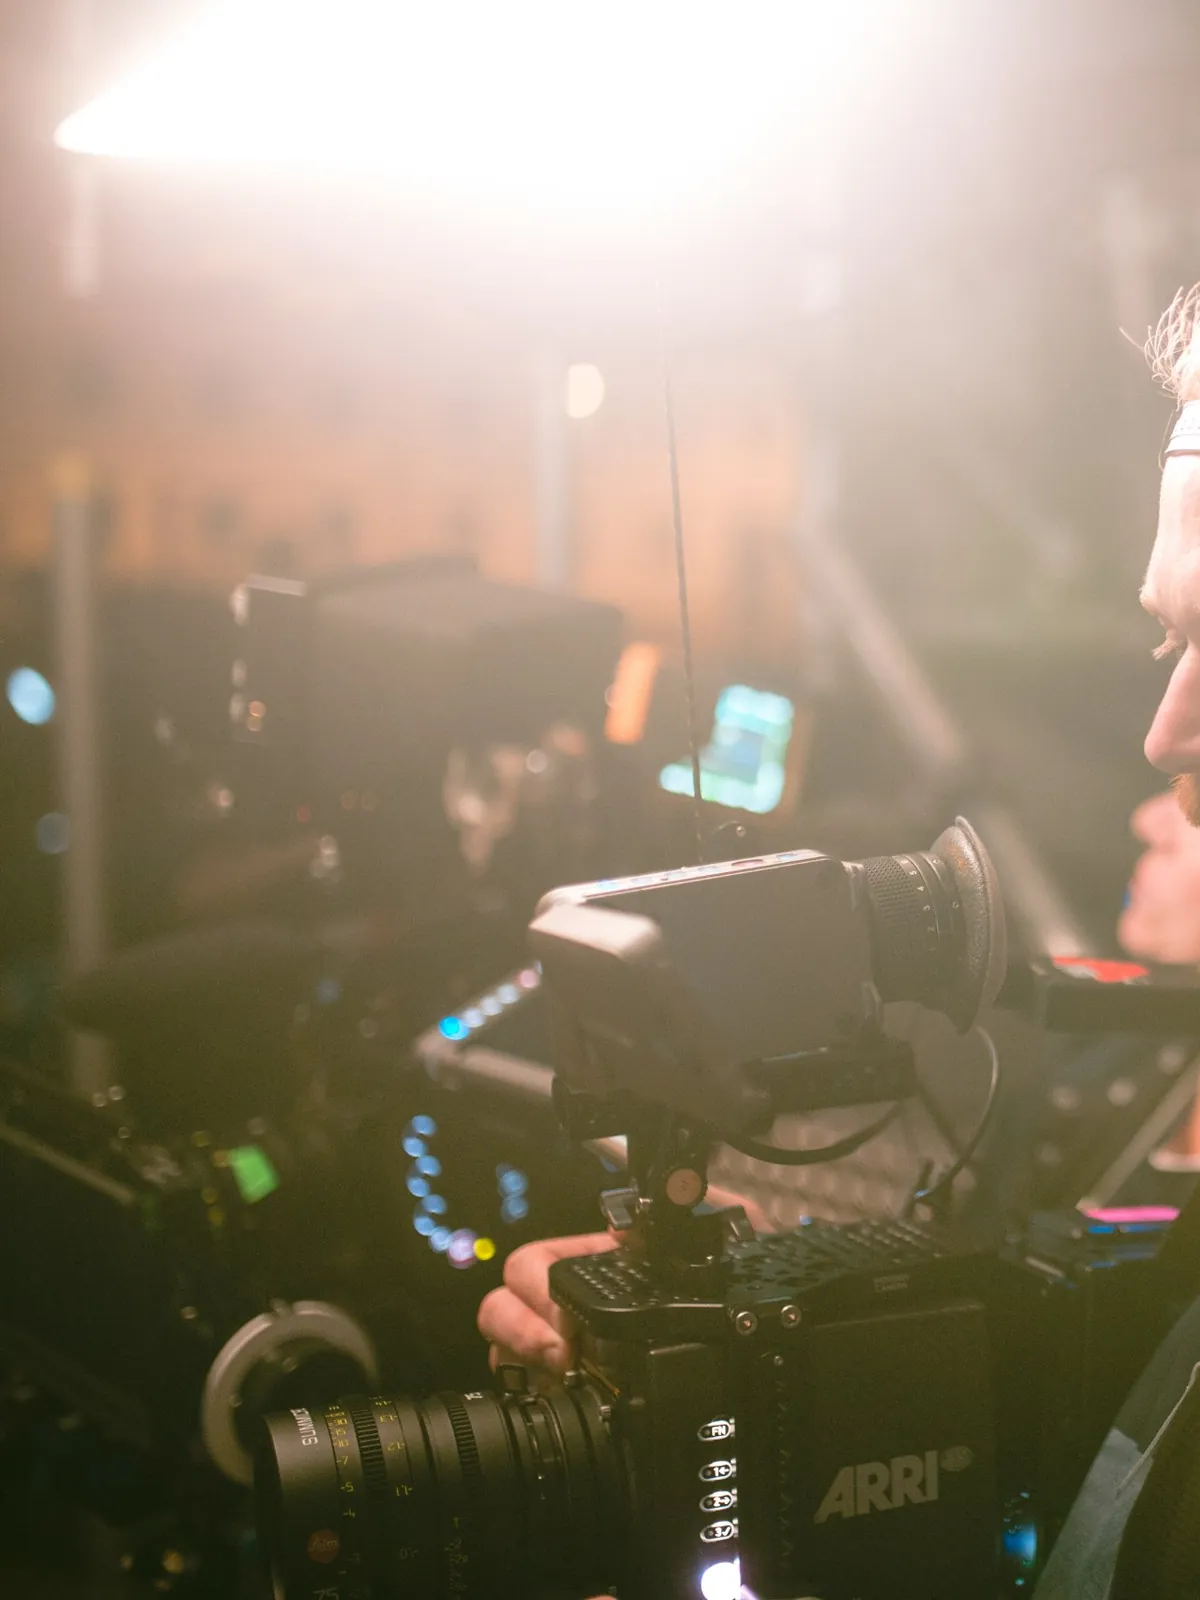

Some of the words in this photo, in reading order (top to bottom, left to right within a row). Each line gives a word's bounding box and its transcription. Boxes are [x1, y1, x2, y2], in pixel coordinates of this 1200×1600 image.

[711, 1425, 726, 1436] FN
[713, 1467, 719, 1477] 1
[813, 1449, 939, 1524] ARRI
[713, 1497, 721, 1508] 2
[714, 1527, 722, 1538] 3
